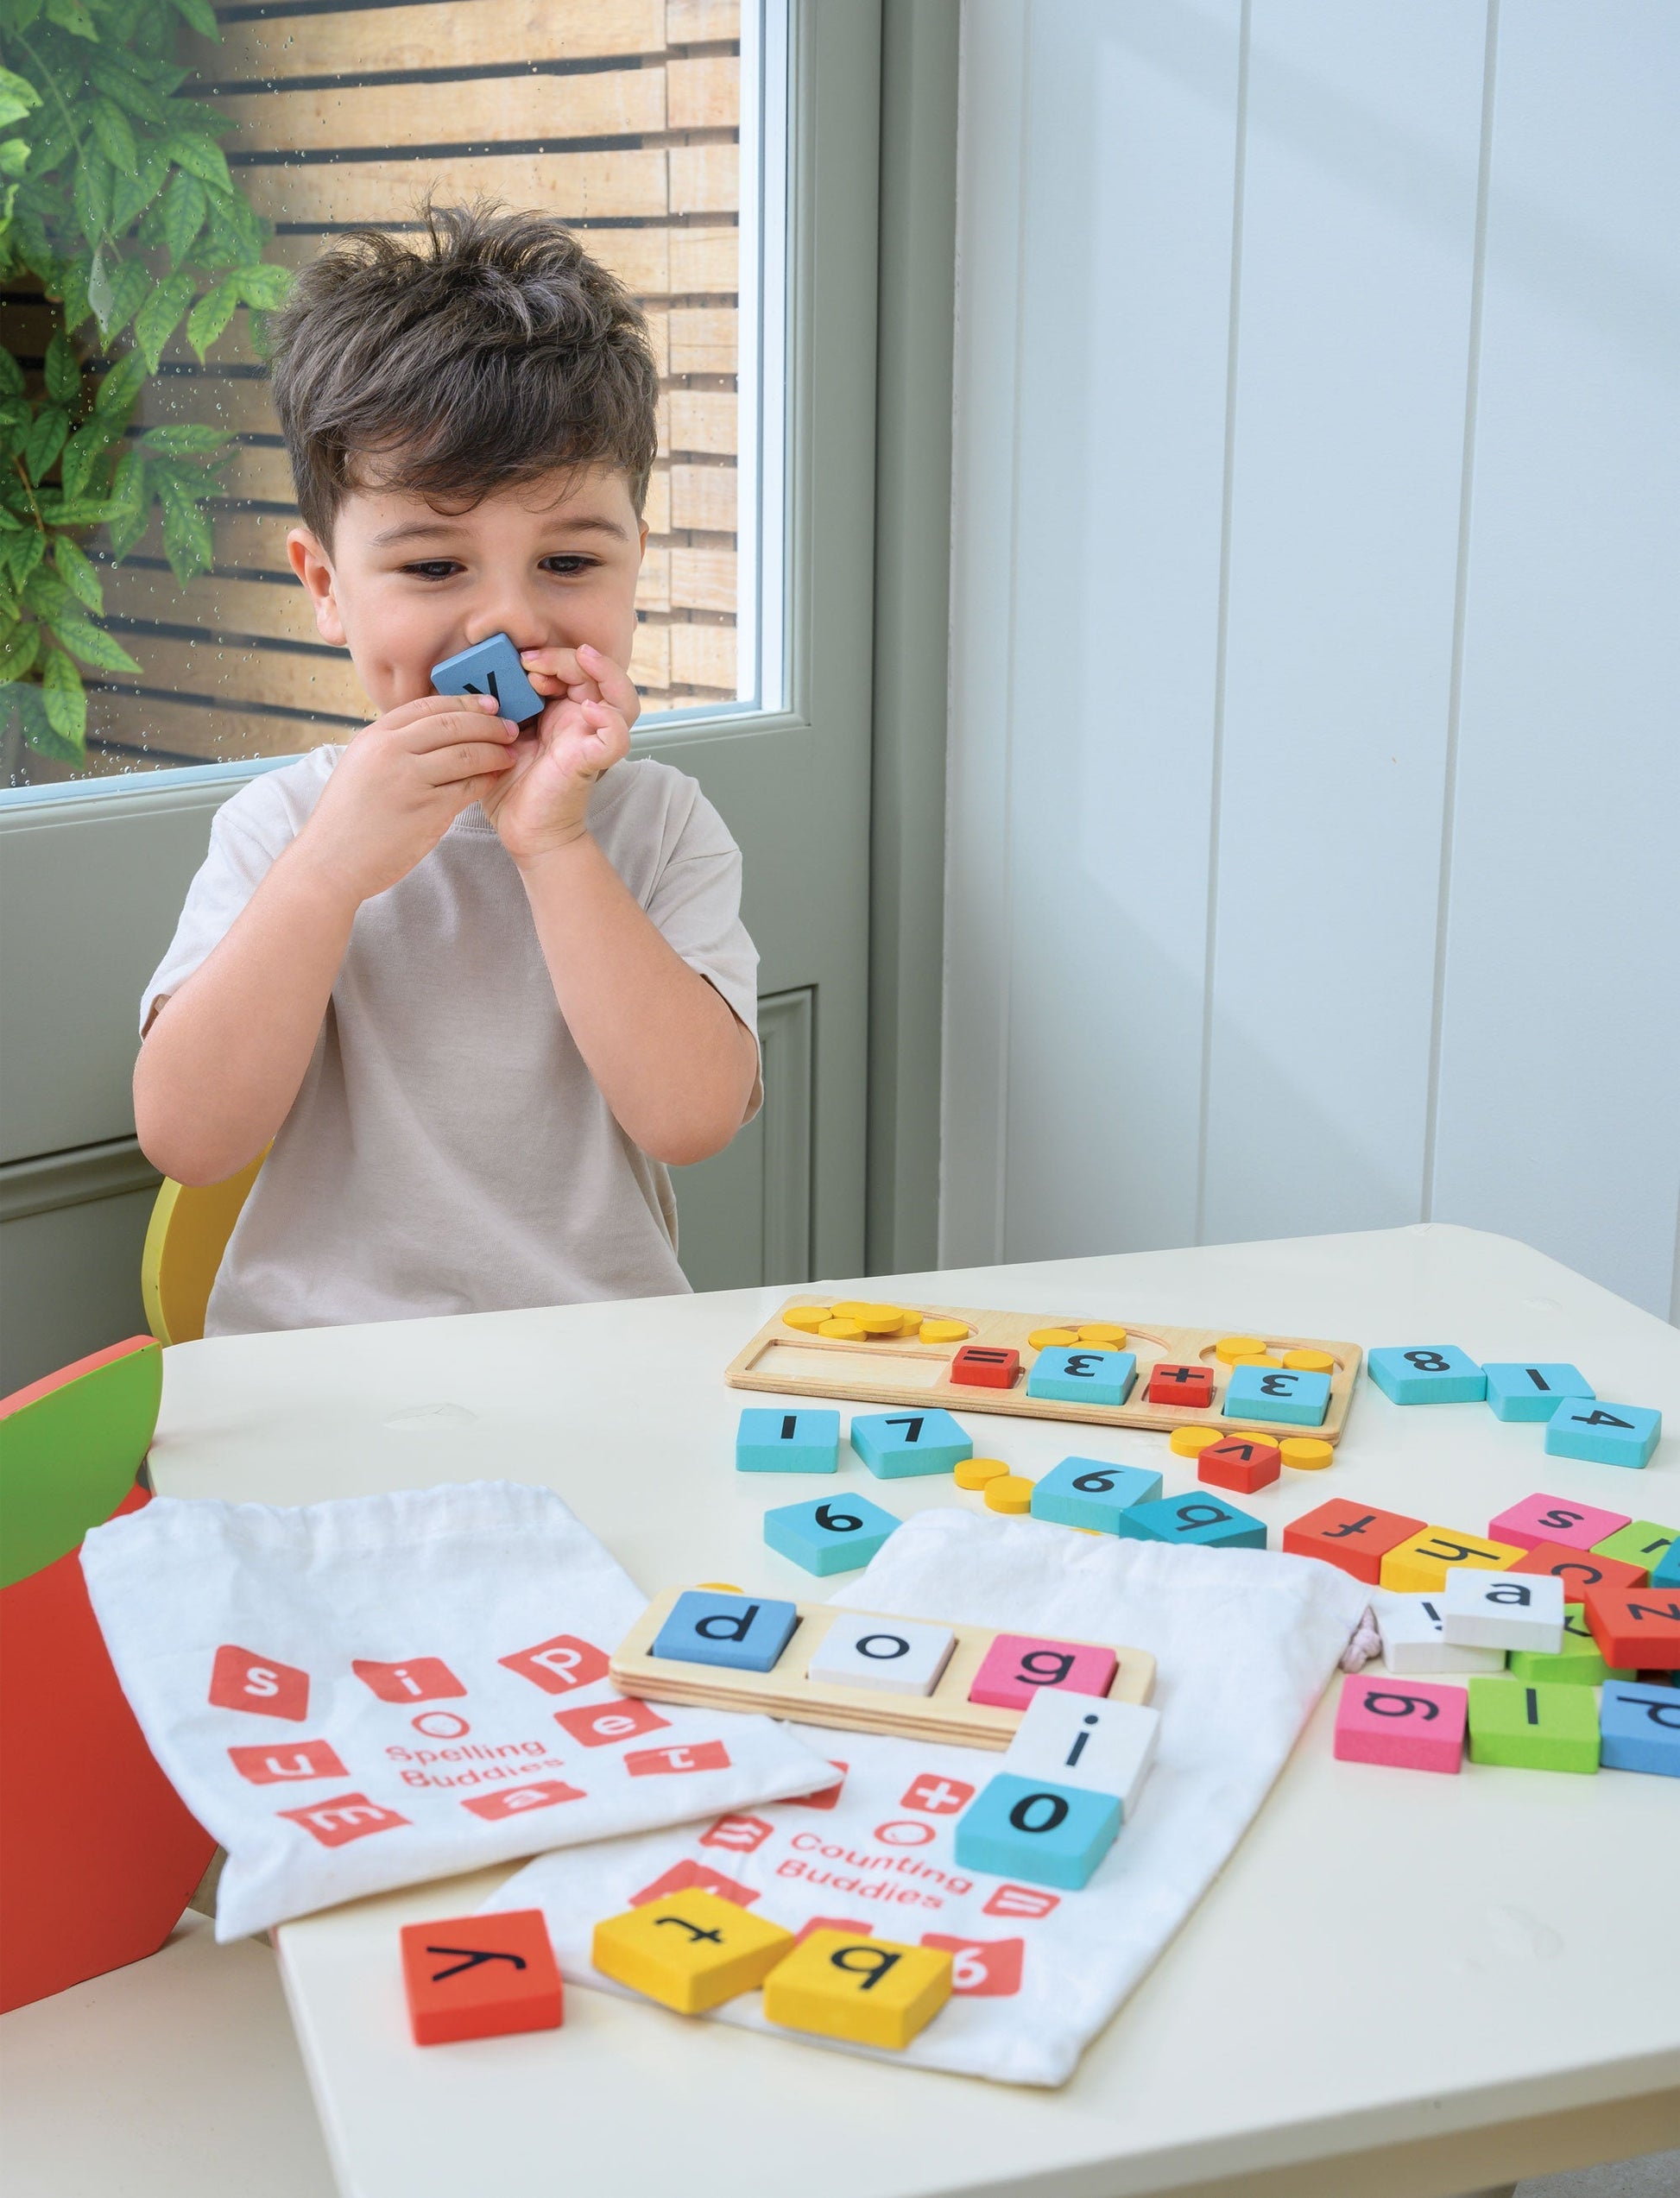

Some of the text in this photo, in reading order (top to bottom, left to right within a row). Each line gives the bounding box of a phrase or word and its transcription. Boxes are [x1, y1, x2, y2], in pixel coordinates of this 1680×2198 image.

[1064, 1355, 1104, 1377] 3
[1404, 1350, 1450, 1372] 8
[1260, 1374, 1299, 1397] 3
[885, 1417, 925, 1443] 7
[1570, 1410, 1635, 1430] 4
[1538, 1510, 1585, 1529] s
[1551, 1563, 1603, 1585] c
[1485, 1583, 1532, 1607] a
[695, 1605, 1076, 1686] d o g
[529, 1646, 583, 1684] p
[243, 1666, 279, 1697] s
[395, 1670, 422, 1696] i
[591, 1714, 635, 1736] e
[385, 1740, 546, 1766] Spelling
[1065, 1715, 1099, 1767] i
[264, 1753, 314, 1776] u
[400, 1759, 565, 1787] Buddies
[791, 1832, 974, 1896] Counting
[775, 1859, 944, 1910] Buddies
[426, 1947, 527, 1982] y
[952, 1947, 988, 1989] 6
